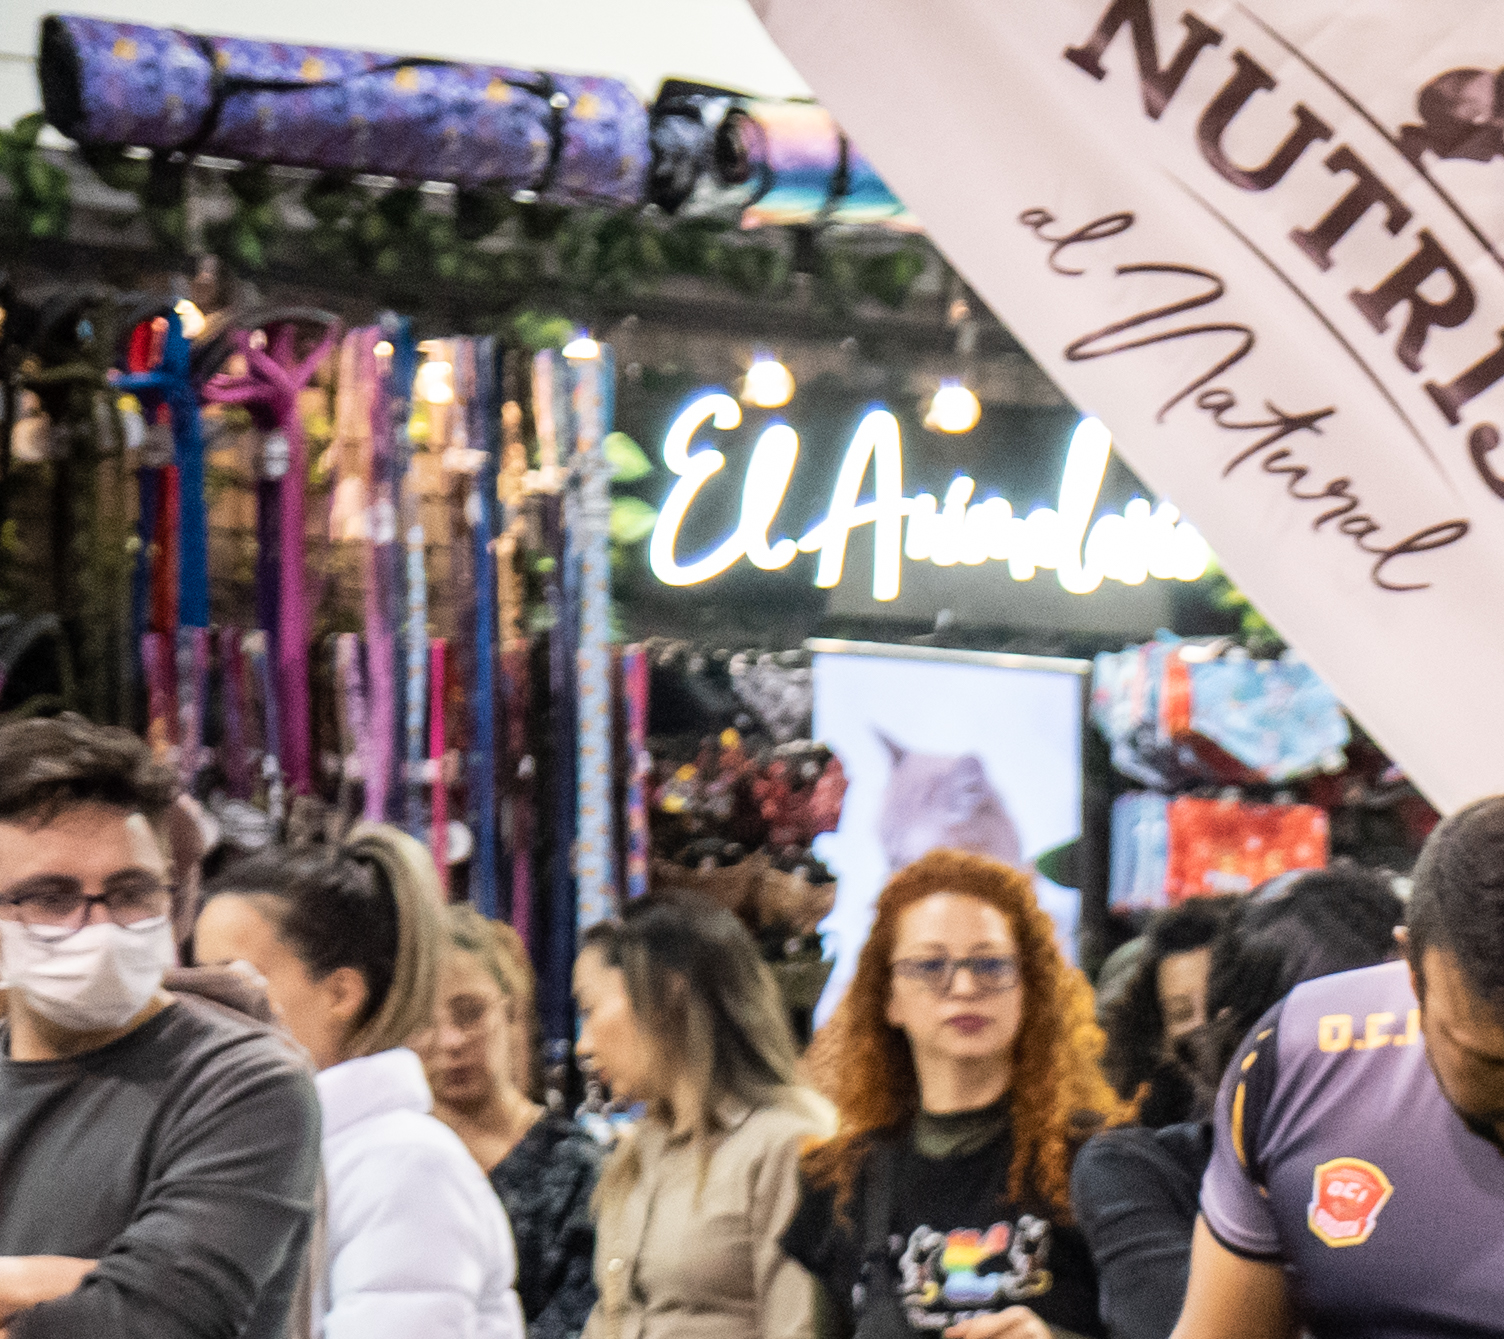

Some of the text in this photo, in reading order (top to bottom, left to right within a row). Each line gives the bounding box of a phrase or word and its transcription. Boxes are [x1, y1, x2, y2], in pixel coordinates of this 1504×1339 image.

[1018, 204, 1134, 276] al
[650, 392, 799, 586] El
[1065, 262, 1469, 592] Natural
